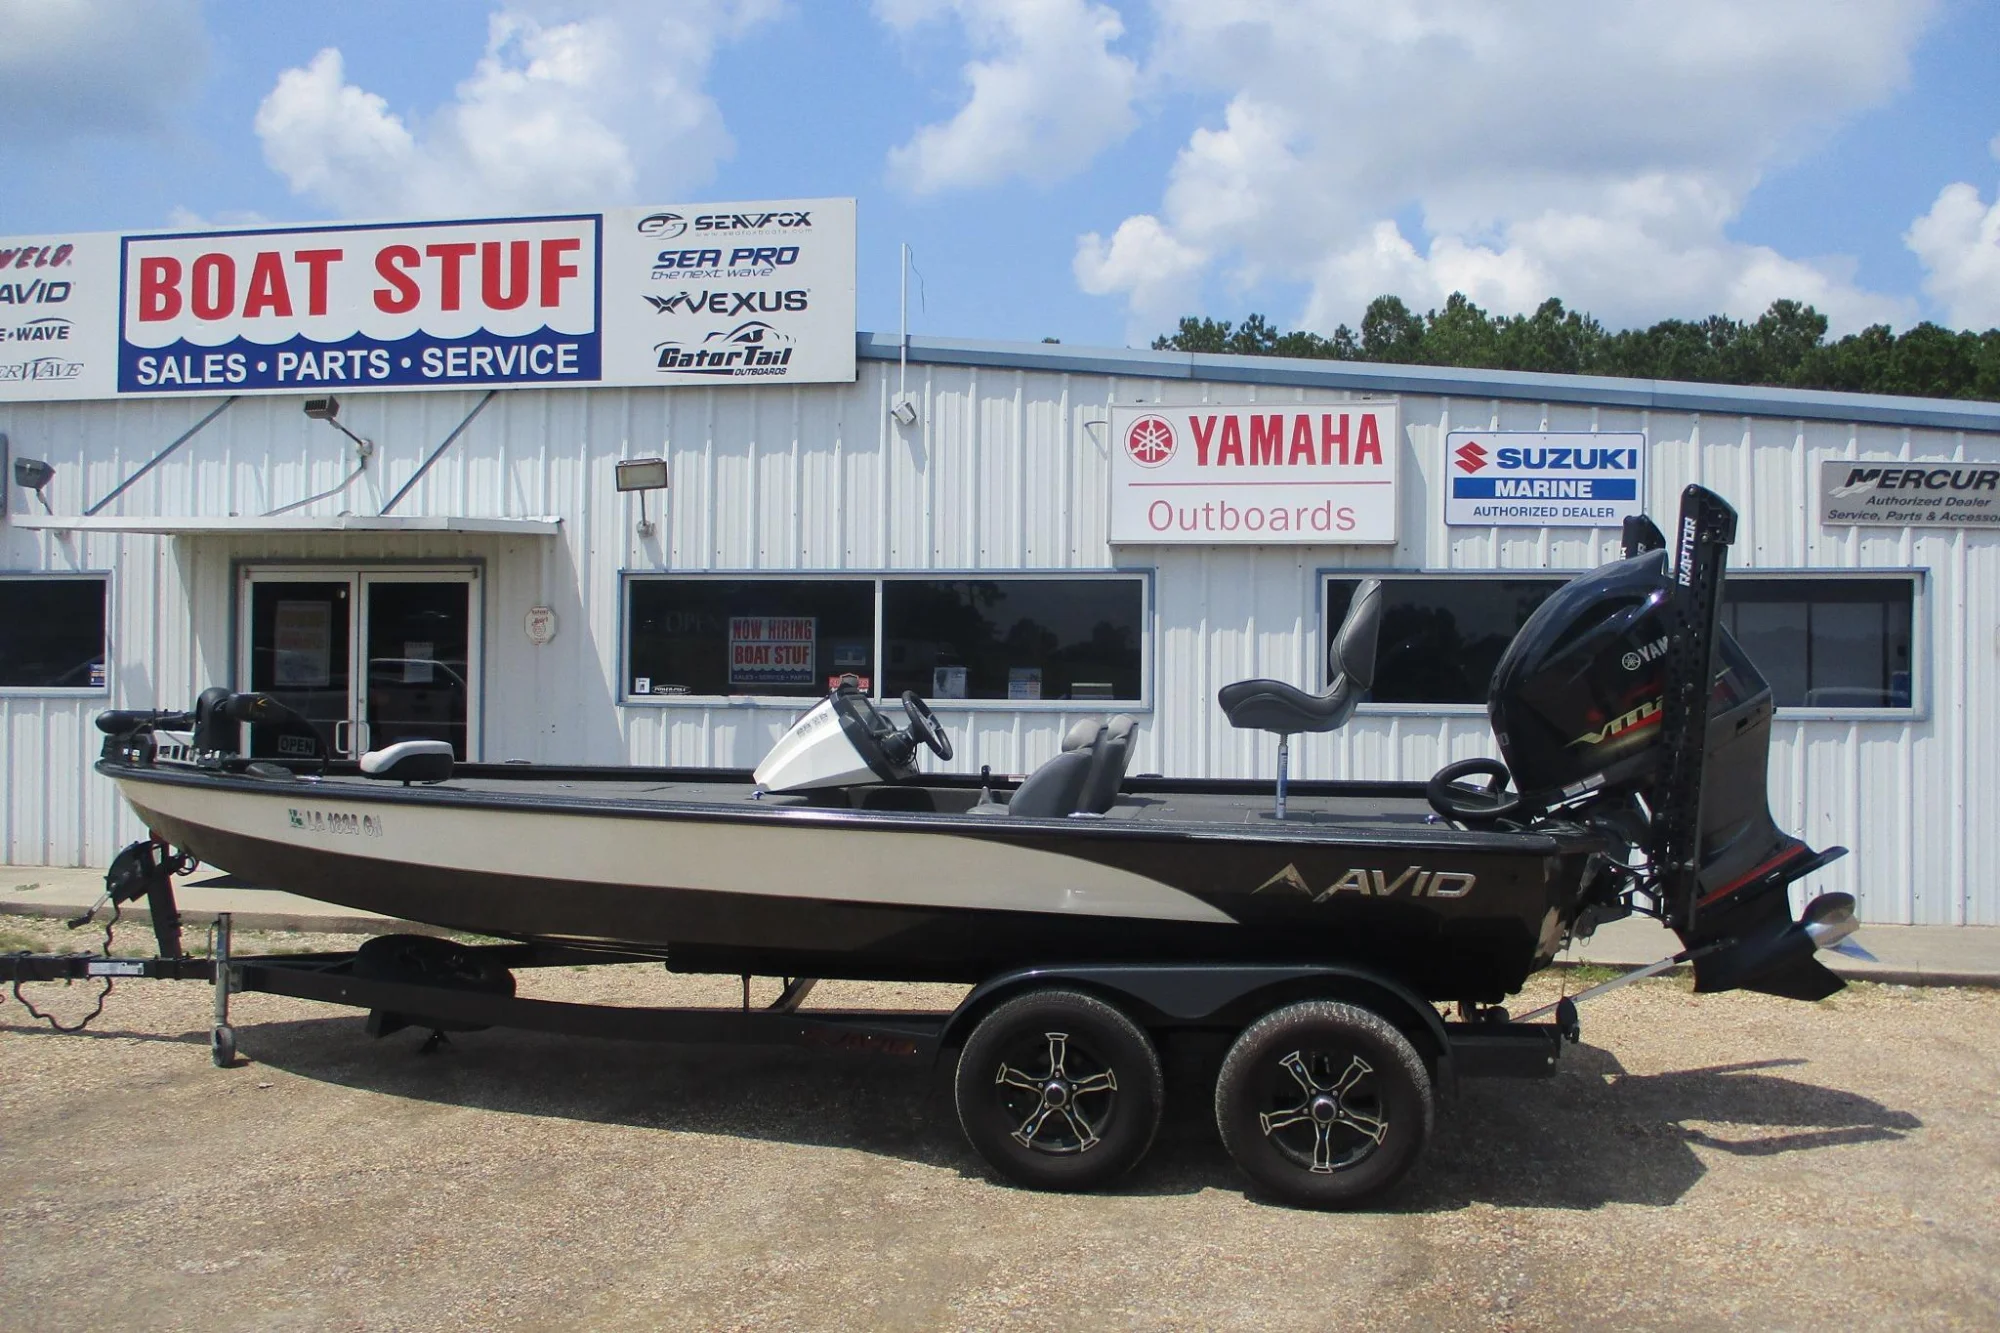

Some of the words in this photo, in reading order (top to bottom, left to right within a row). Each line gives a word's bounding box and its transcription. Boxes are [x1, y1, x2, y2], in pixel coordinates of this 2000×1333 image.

[652, 249, 722, 270] SEA
[728, 246, 800, 270] PRO
[139, 249, 343, 322] BOAT
[373, 238, 581, 314] STUF
[651, 269, 680, 280] the
[682, 269, 724, 279] next
[727, 267, 774, 278] wave
[0, 278, 72, 304] AVID
[680, 290, 808, 317] VEXUS
[137, 352, 247, 386] SALES
[278, 349, 390, 382] PARTS
[422, 343, 579, 378] SERVICE
[734, 367, 788, 376] OUTBOARDS
[1188, 413, 1383, 466] YAMAHA
[1496, 448, 1637, 470] SUZUKI
[1494, 480, 1593, 498] MARINE
[1844, 468, 2000, 490] MERCUR
[1473, 506, 1558, 518] AUTHORIZED
[1562, 507, 1615, 518] DEALER
[1866, 495, 1942, 506] Authorized
[1945, 496, 1992, 507] Dealer
[1148, 500, 1356, 531] Outboards
[1828, 510, 1881, 521] Service,
[1885, 511, 1922, 521] Parts
[1926, 511, 1936, 521] &
[1938, 511, 2000, 522] Accesso
[1679, 516, 1697, 587] RAPTOR
[733, 619, 762, 639] NOW
[768, 619, 813, 640] HIRING
[734, 645, 771, 665] BOAT
[774, 645, 810, 665] STUF
[1637, 635, 1669, 662] YAM
[280, 737, 313, 753] OPEN
[1312, 865, 1477, 903] AVID
